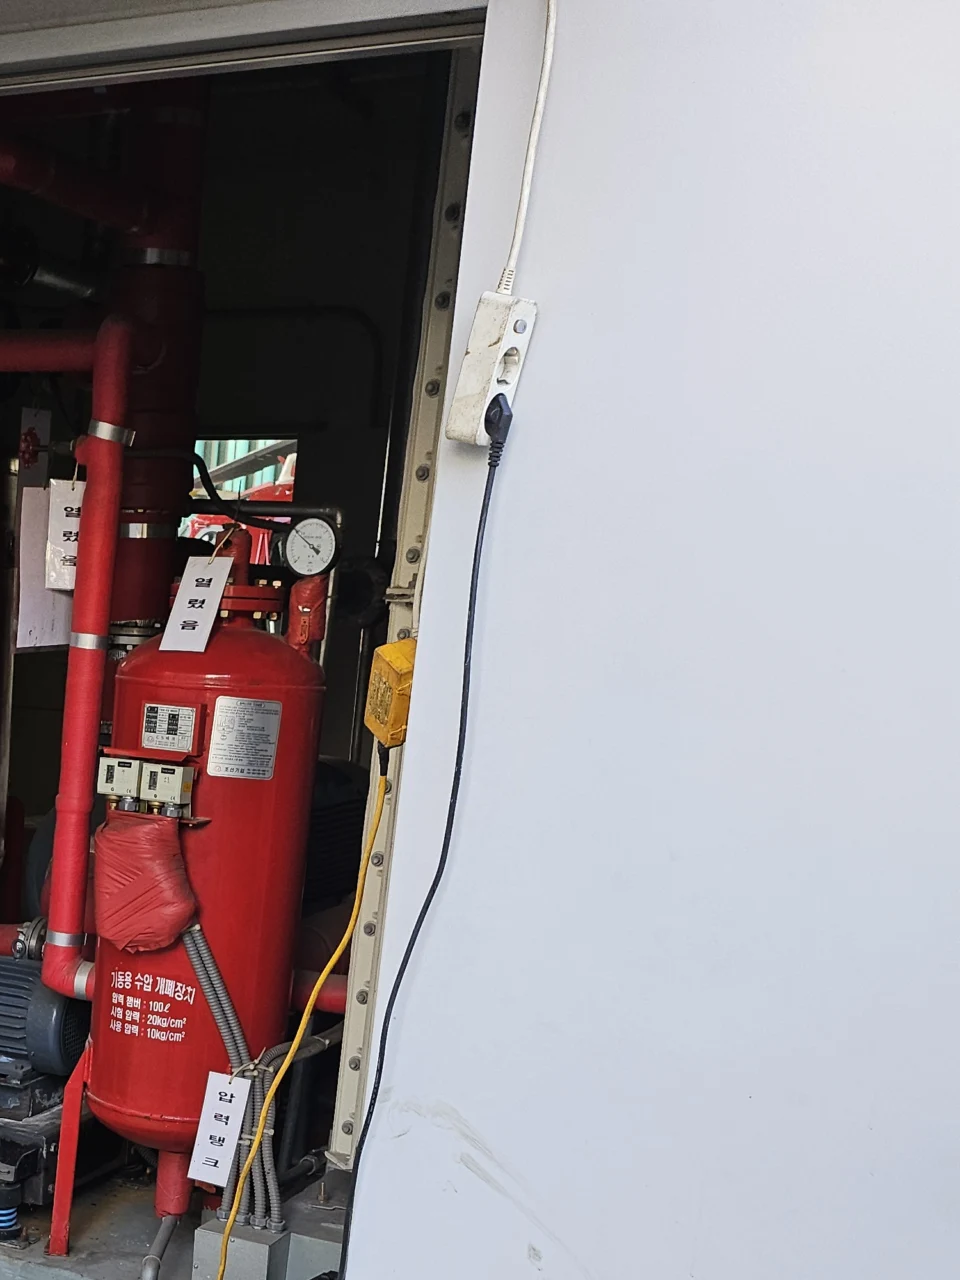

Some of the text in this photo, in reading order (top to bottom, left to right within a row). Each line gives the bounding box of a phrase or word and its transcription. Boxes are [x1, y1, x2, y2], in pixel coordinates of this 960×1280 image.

[179, 577, 214, 631] 열렸음
[111, 971, 196, 1006] 기동용 수압 개폐장치
[111, 992, 125, 1006] 압력
[126, 996, 141, 1009] 챔버
[110, 1005, 123, 1019] 시험
[125, 1010, 140, 1023] 압력
[109, 1019, 122, 1033] 사용
[124, 1023, 139, 1037] 압력
[202, 1091, 236, 1169] 압력탱크
